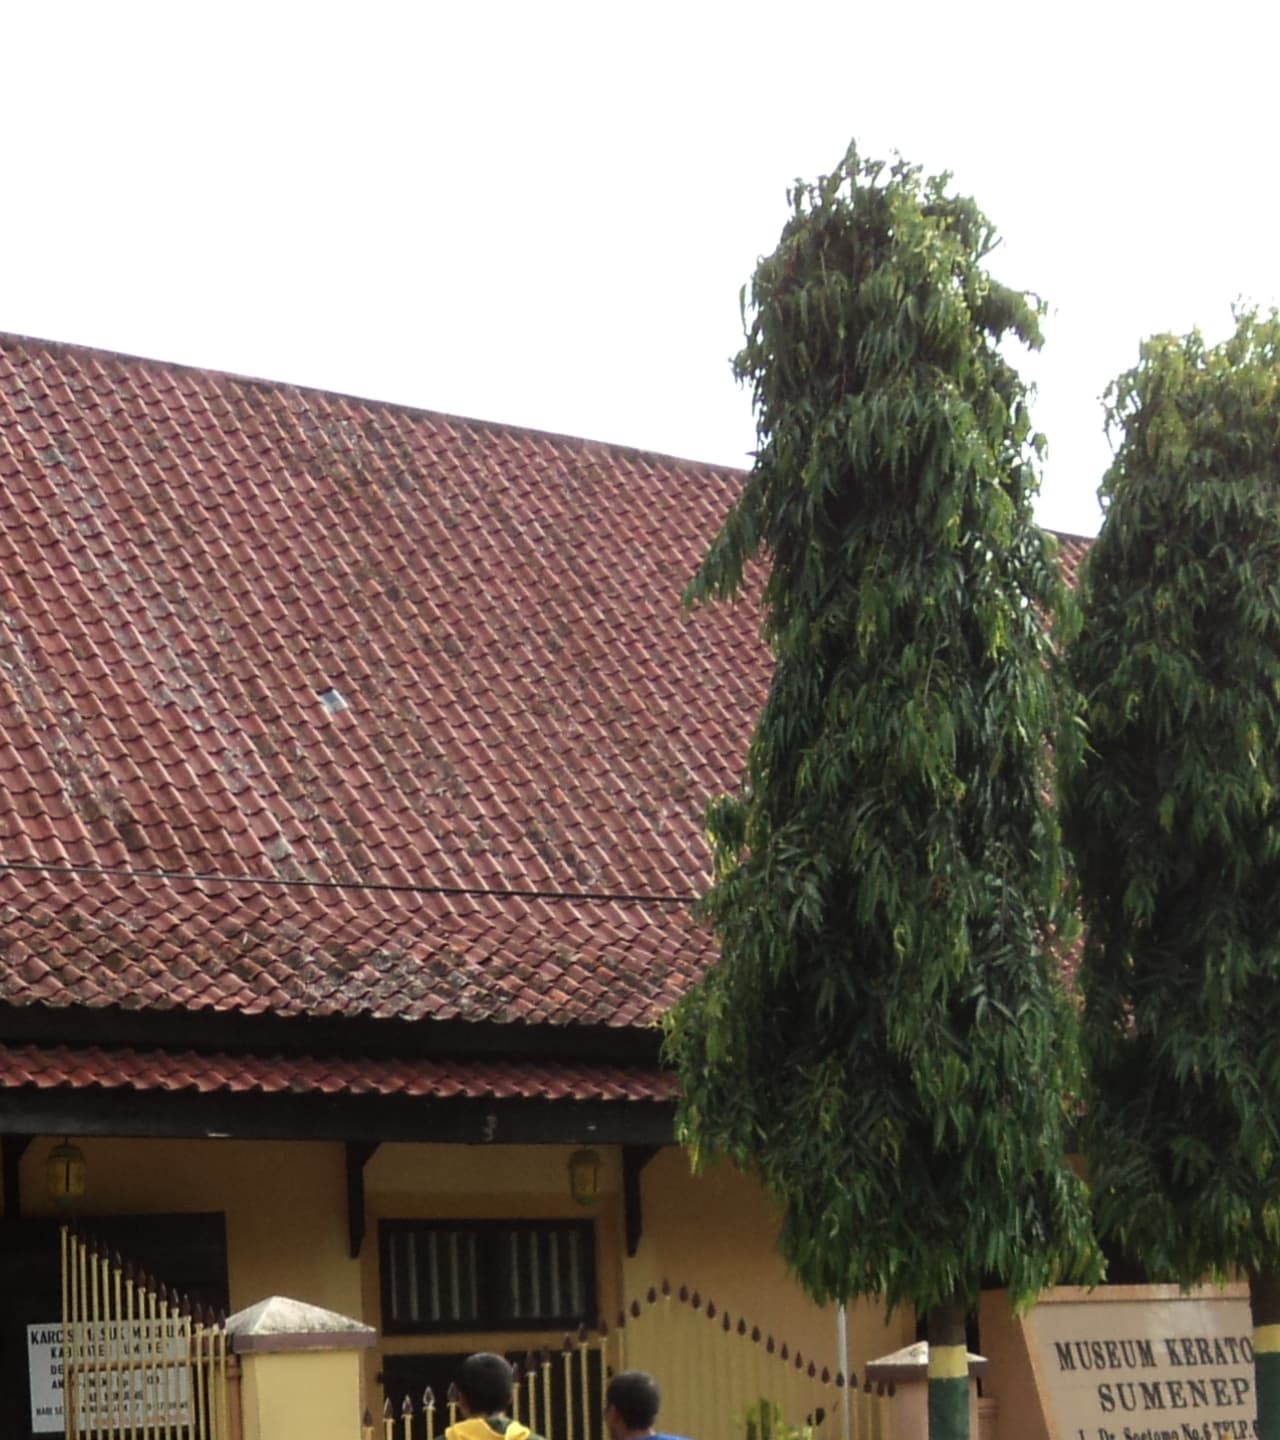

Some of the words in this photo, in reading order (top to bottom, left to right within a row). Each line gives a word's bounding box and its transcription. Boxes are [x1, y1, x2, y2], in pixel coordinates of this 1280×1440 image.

[30, 1329, 75, 1346] KARCS
[1054, 1338, 1157, 1371] MUSEUM
[1164, 1335, 1255, 1367] KERATO
[1098, 1377, 1251, 1413] SUMENEP
